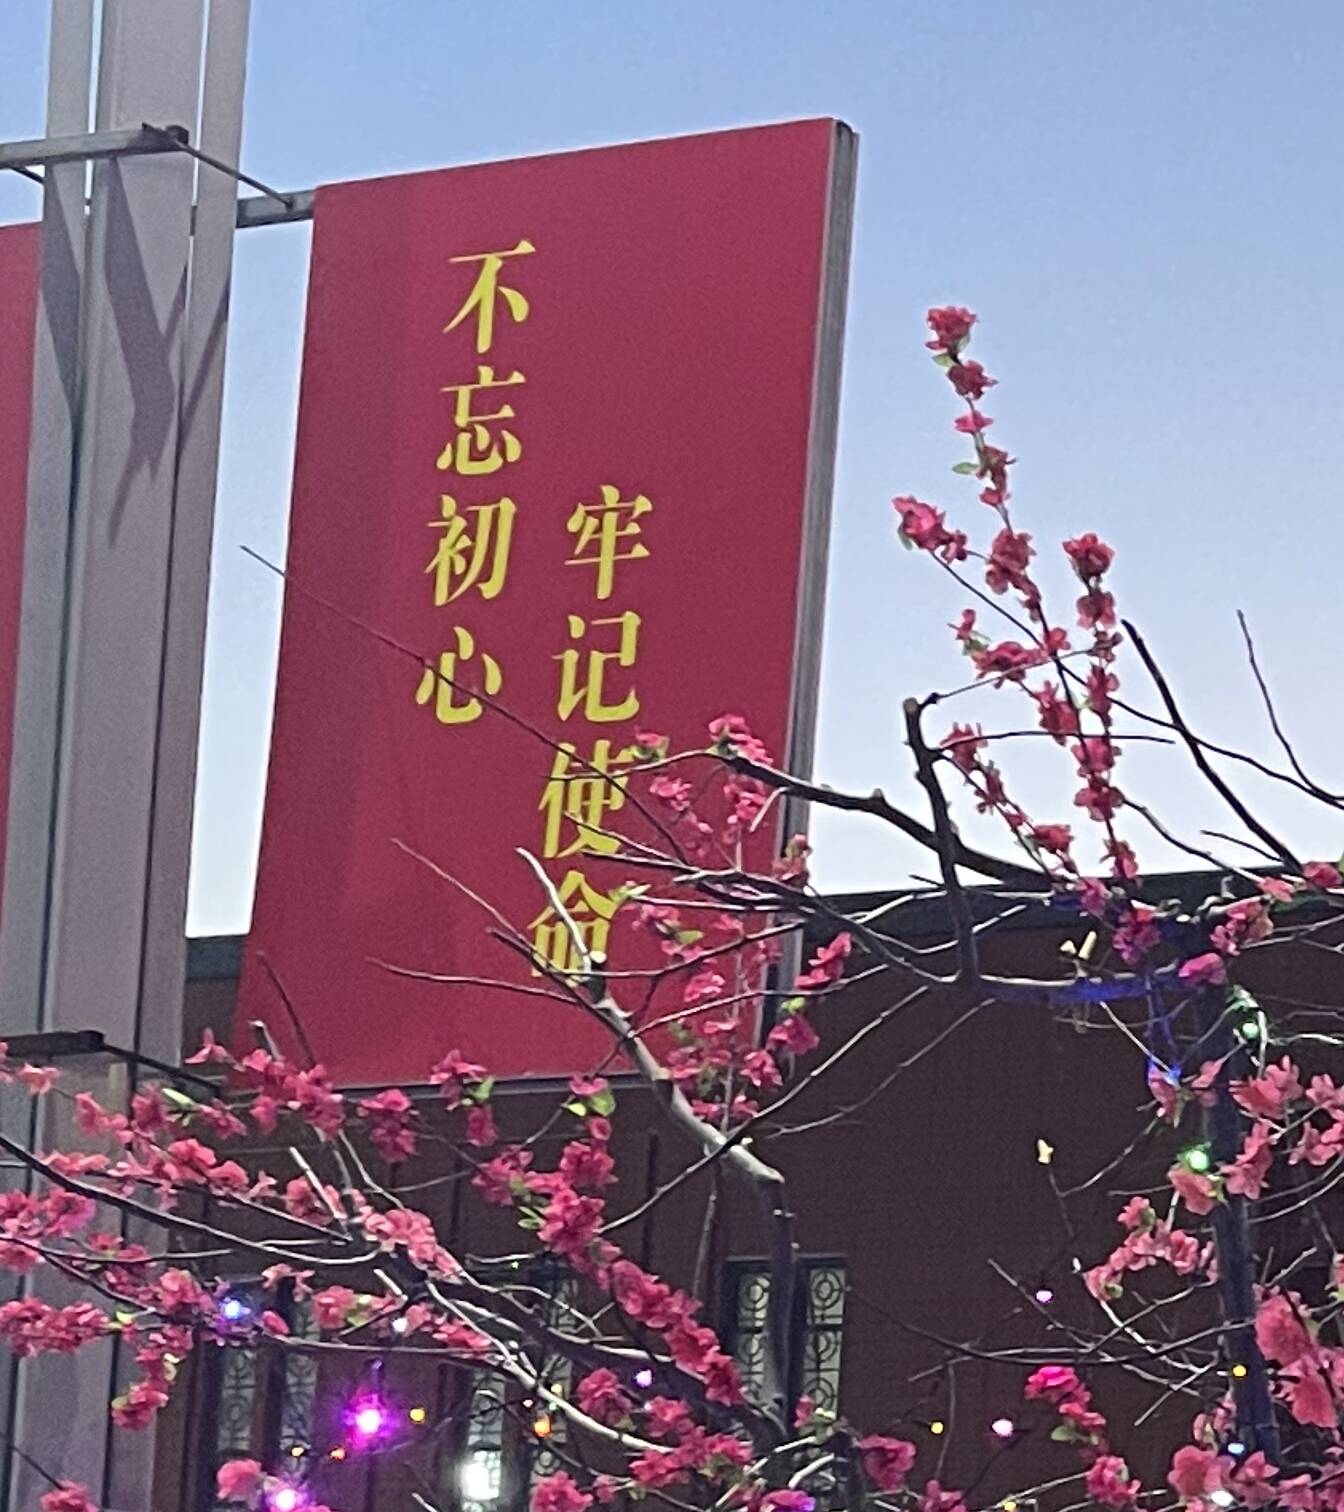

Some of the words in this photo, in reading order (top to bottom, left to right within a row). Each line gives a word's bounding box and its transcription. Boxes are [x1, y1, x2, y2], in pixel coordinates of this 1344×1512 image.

[415, 239, 536, 724] 不忘初心
[528, 484, 652, 989] 牢记使命
